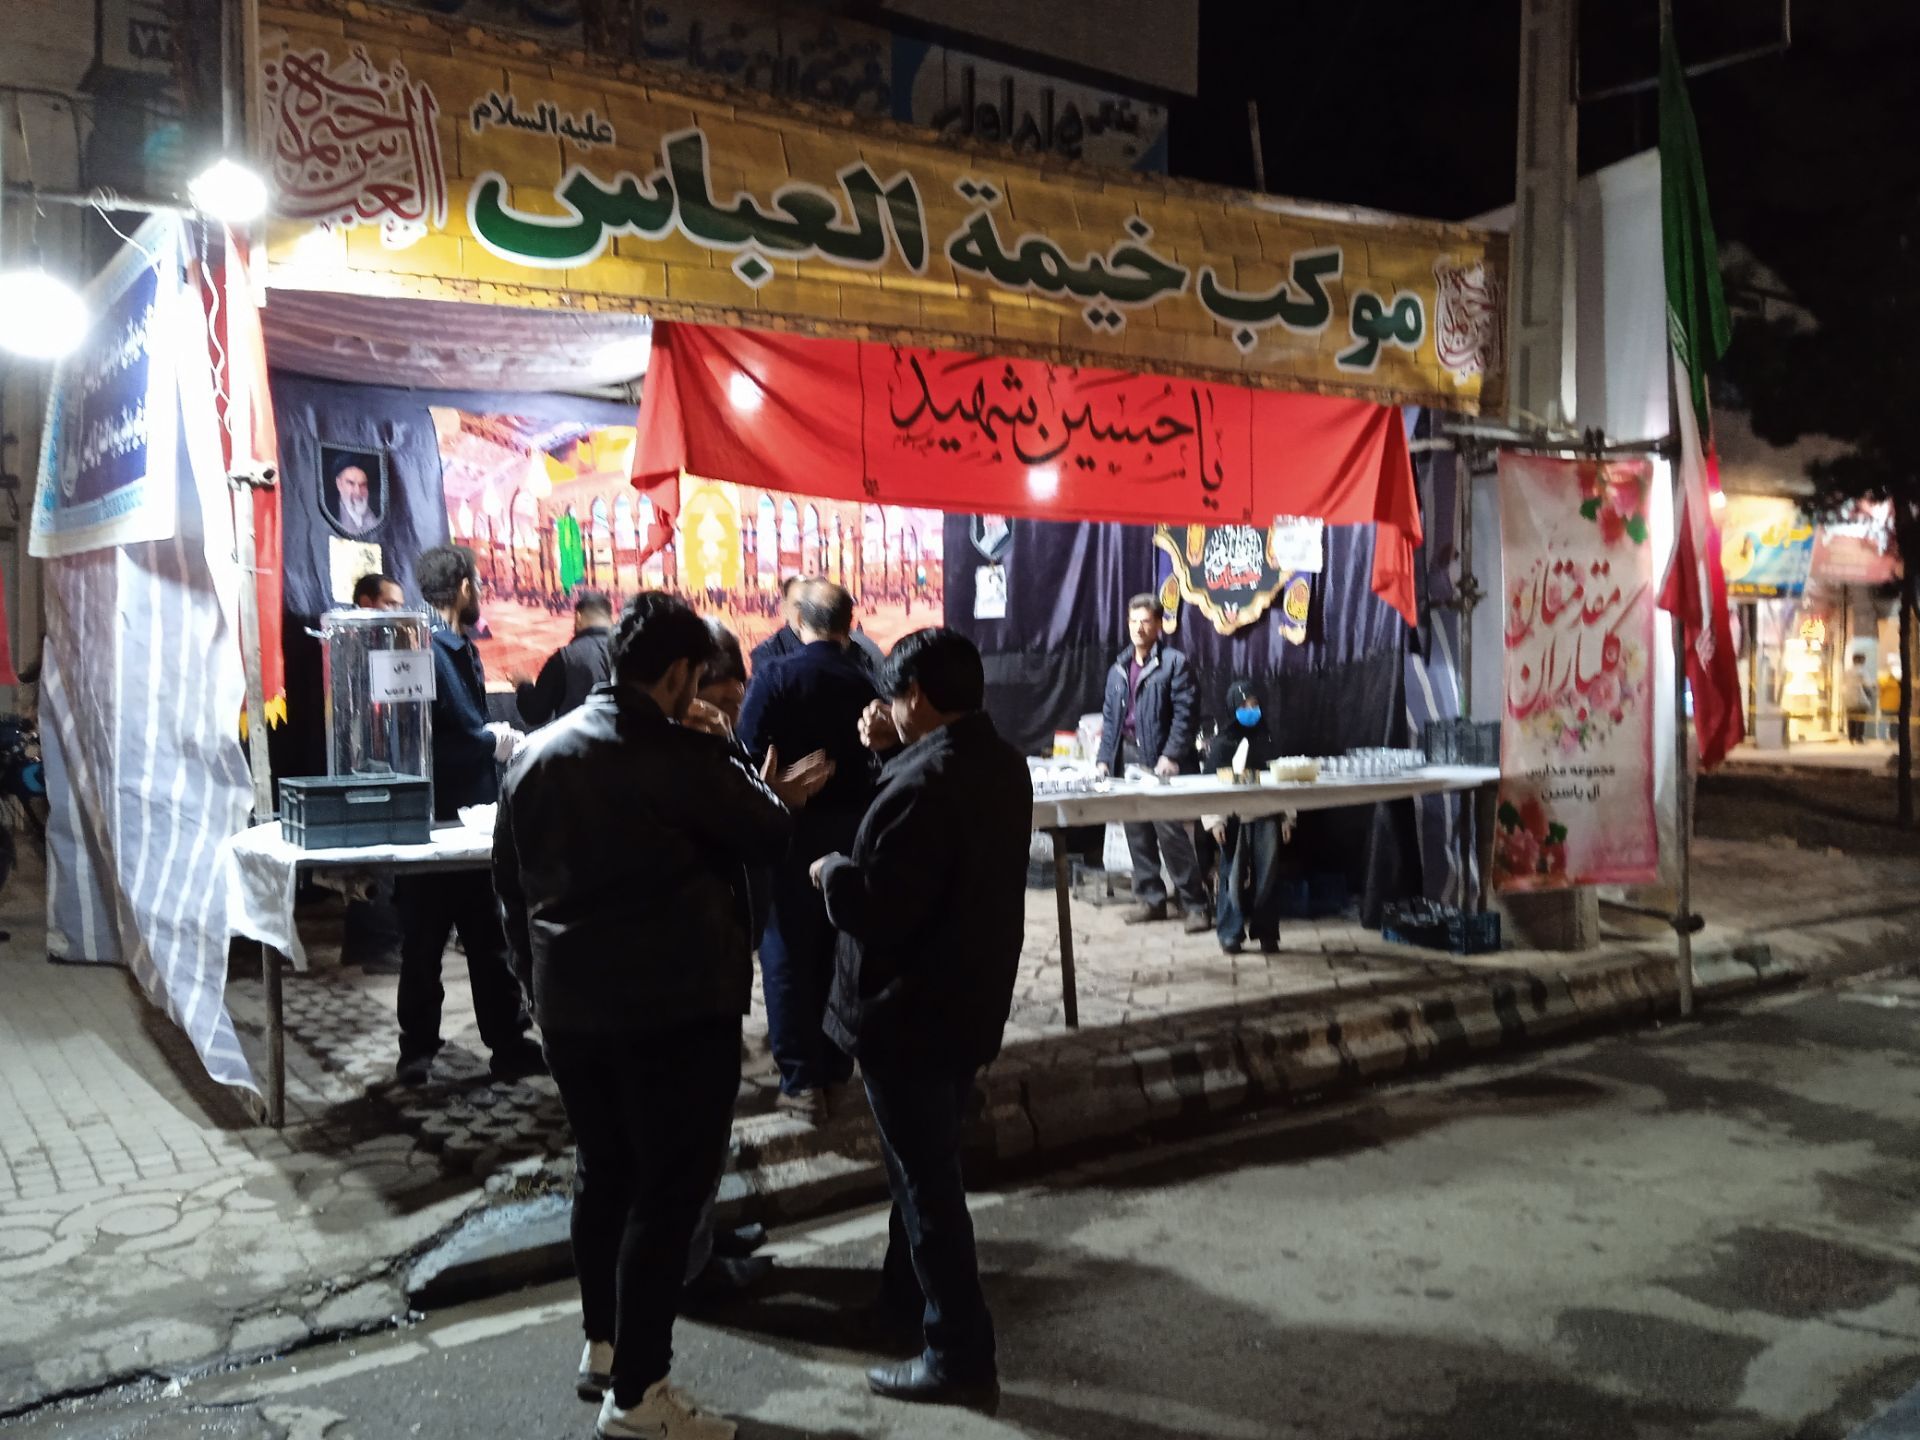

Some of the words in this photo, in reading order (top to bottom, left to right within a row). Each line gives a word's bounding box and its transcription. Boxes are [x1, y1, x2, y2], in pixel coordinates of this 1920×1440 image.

[472, 97, 557, 139] السلام
[556, 111, 613, 147] علیه
[474, 131, 926, 282] العباس
[949, 182, 1189, 329] خیمة
[1201, 248, 1424, 369] موکب
[888, 354, 1039, 452] شهید
[1012, 401, 1195, 473] حسین
[1191, 386, 1224, 510] یا
[1504, 557, 1622, 649] مقدمتان
